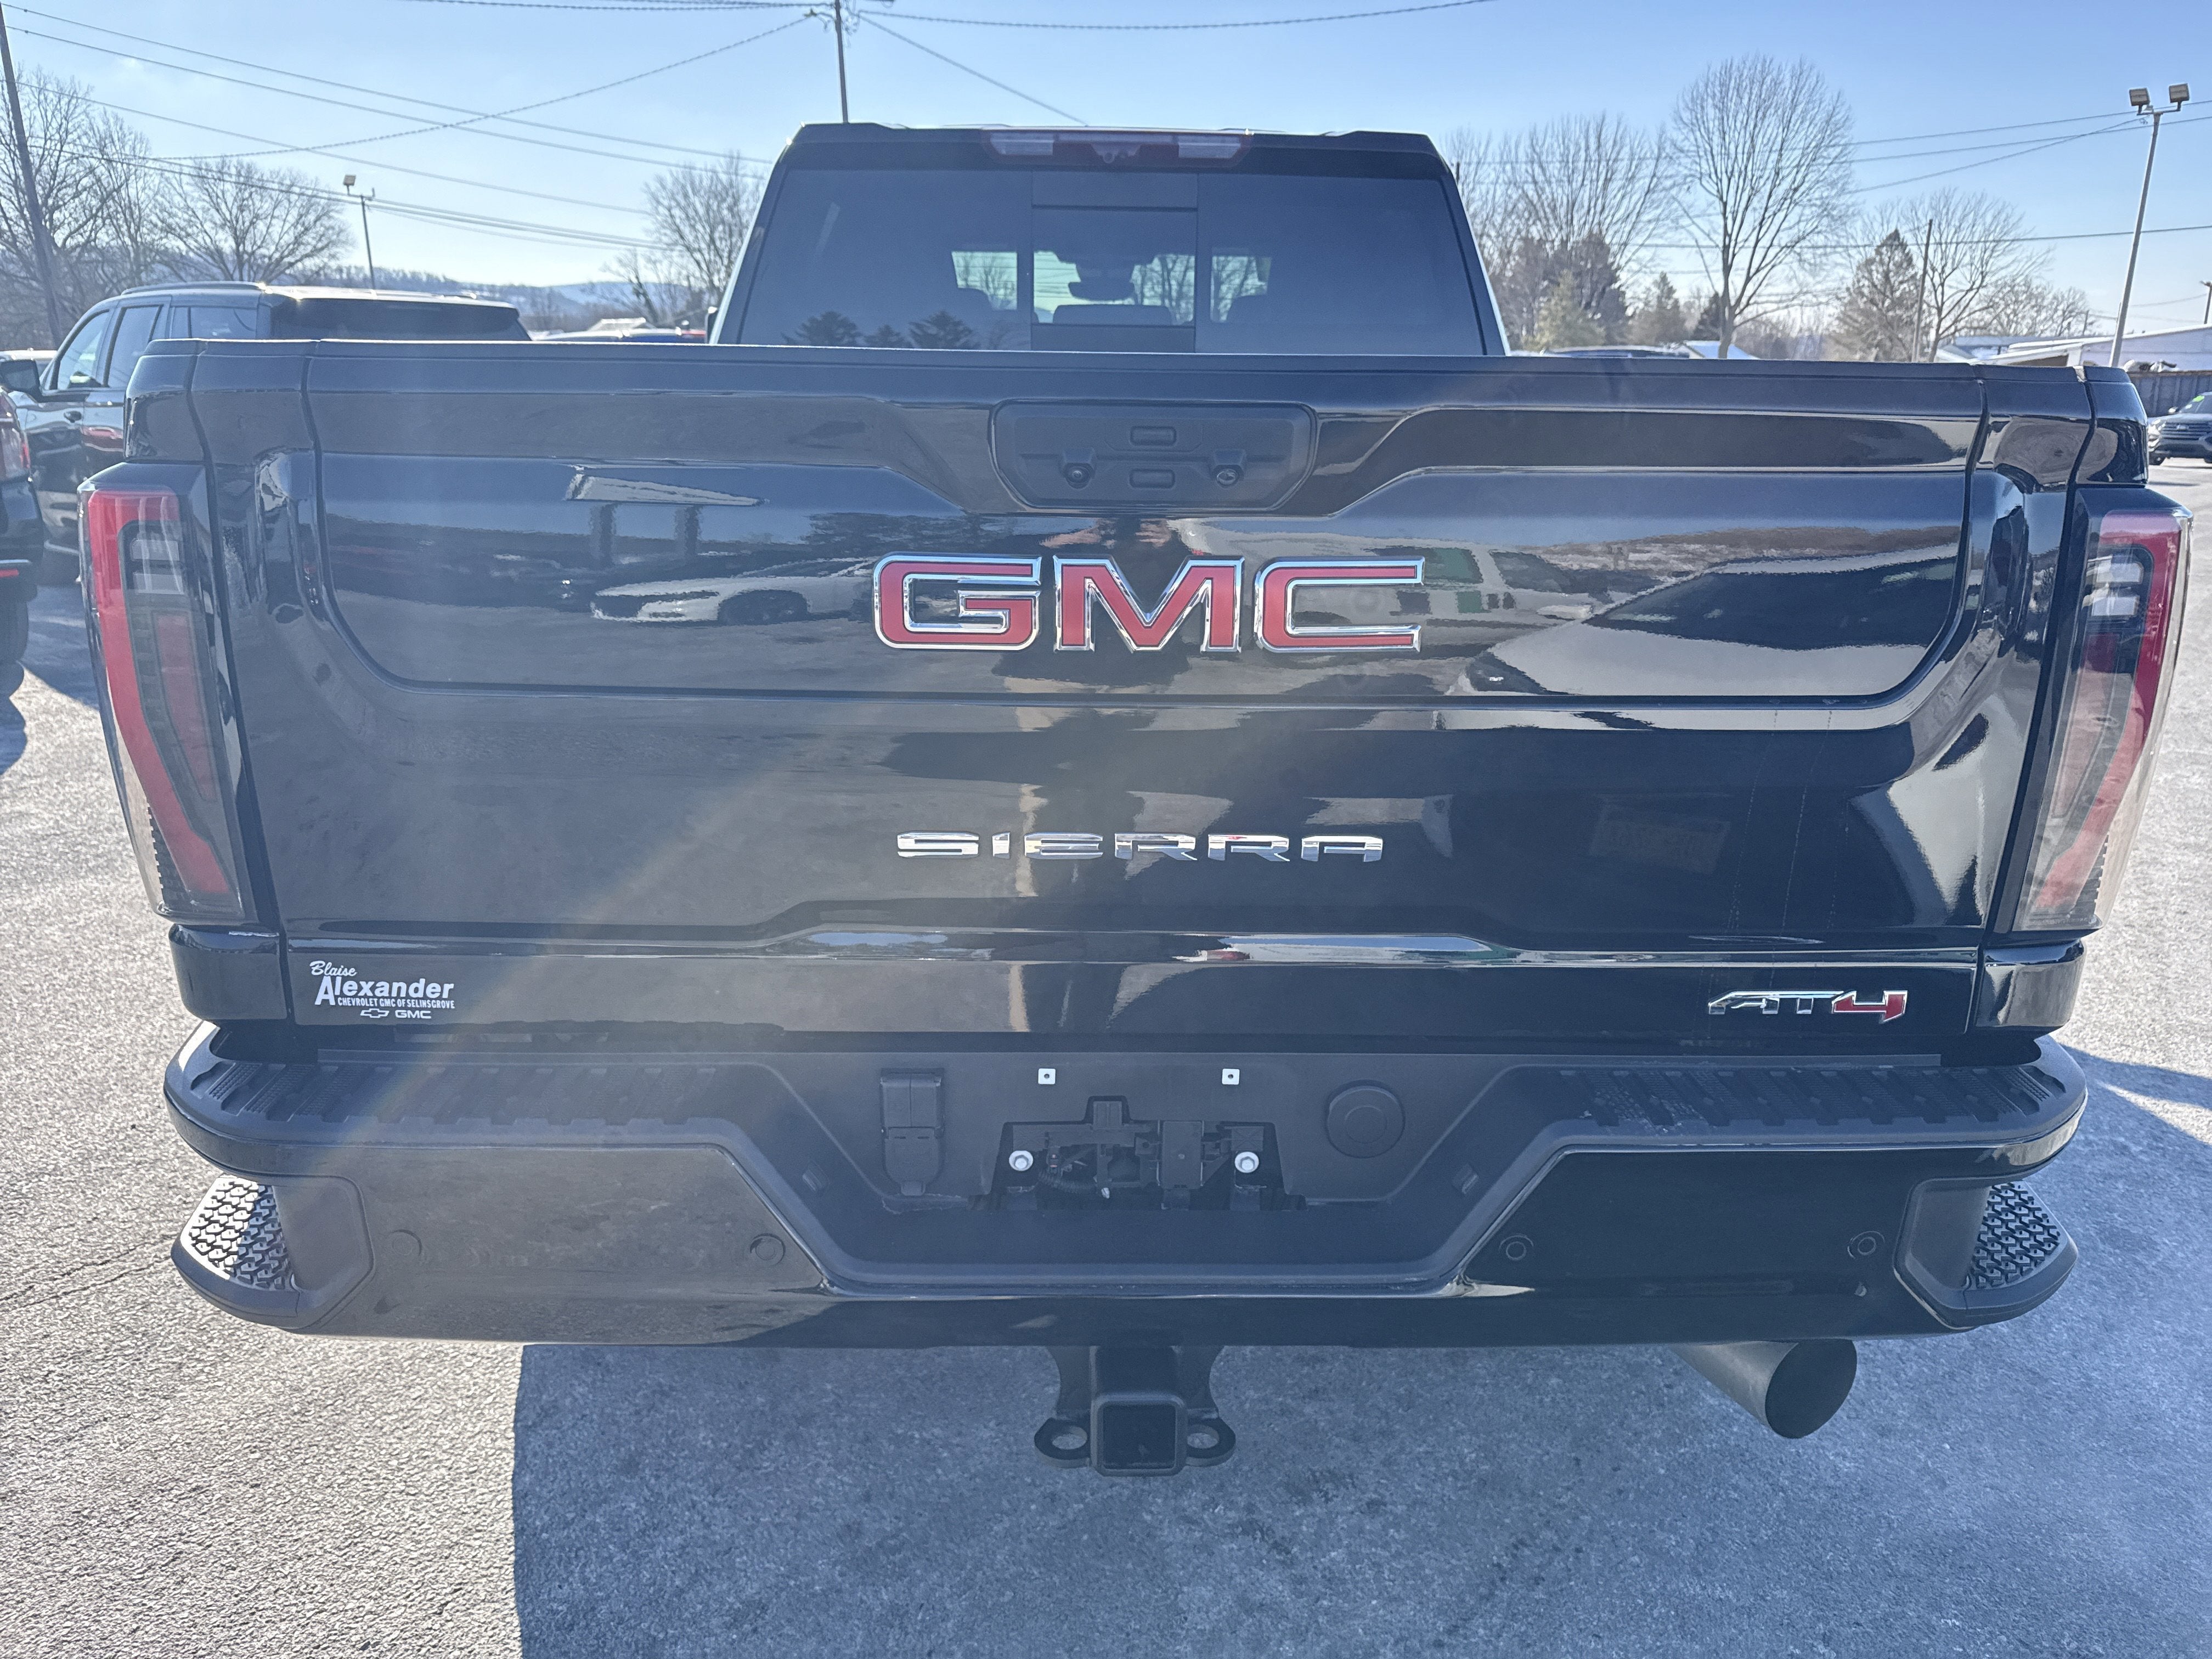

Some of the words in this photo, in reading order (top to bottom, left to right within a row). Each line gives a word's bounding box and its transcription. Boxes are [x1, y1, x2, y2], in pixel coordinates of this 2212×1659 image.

[873, 554, 1425, 653] GMC
[896, 831, 1384, 862] SIERRA
[309, 960, 357, 977] Blaise
[314, 975, 455, 1006] Alexander
[337, 997, 378, 1007] CHEVROLET
[379, 998, 396, 1007] GMC
[397, 998, 407, 1008] OF
[407, 999, 456, 1009] SELINSGROVE
[394, 1009, 432, 1019] GMC
[1707, 990, 1909, 1024] AT4
